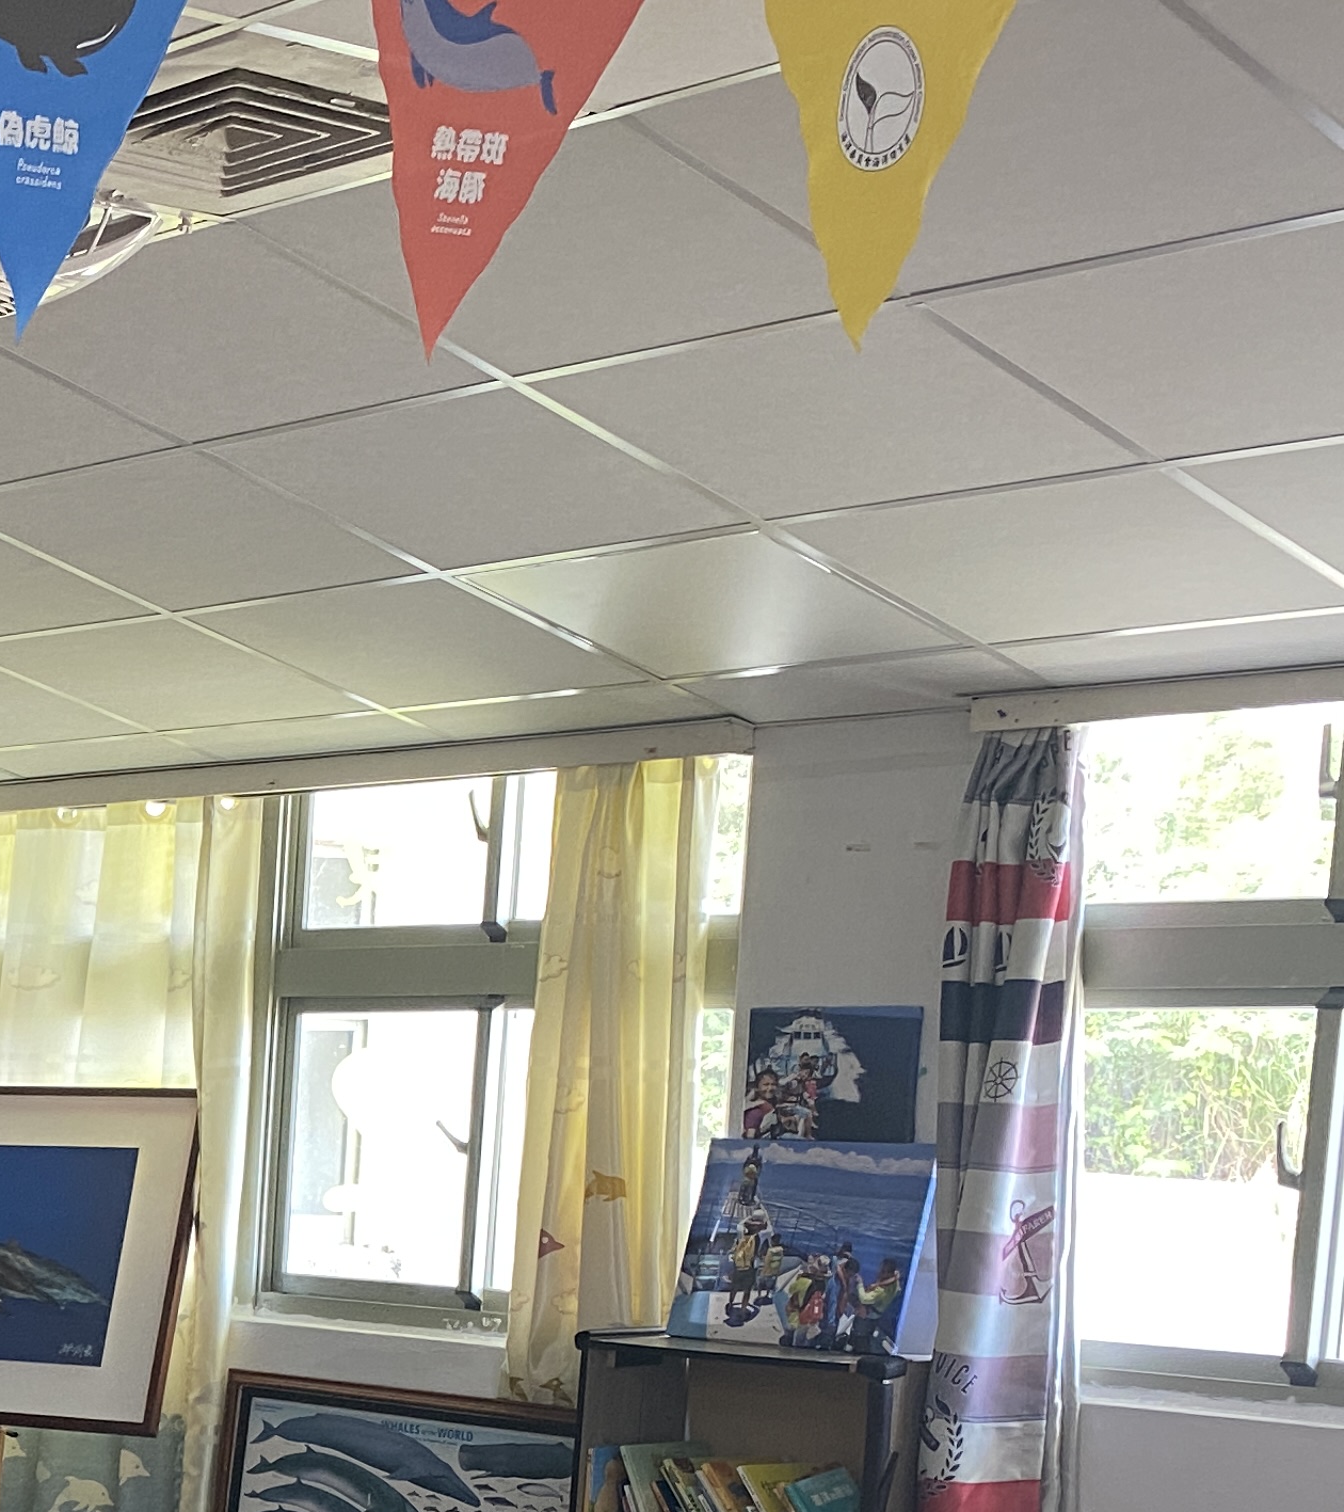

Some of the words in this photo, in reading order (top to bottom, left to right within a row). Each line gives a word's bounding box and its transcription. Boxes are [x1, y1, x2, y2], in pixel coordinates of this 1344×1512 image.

[434, 168, 487, 204] 海豚
[381, 1420, 420, 1435] WHALES
[437, 1427, 474, 1441] WORLD
